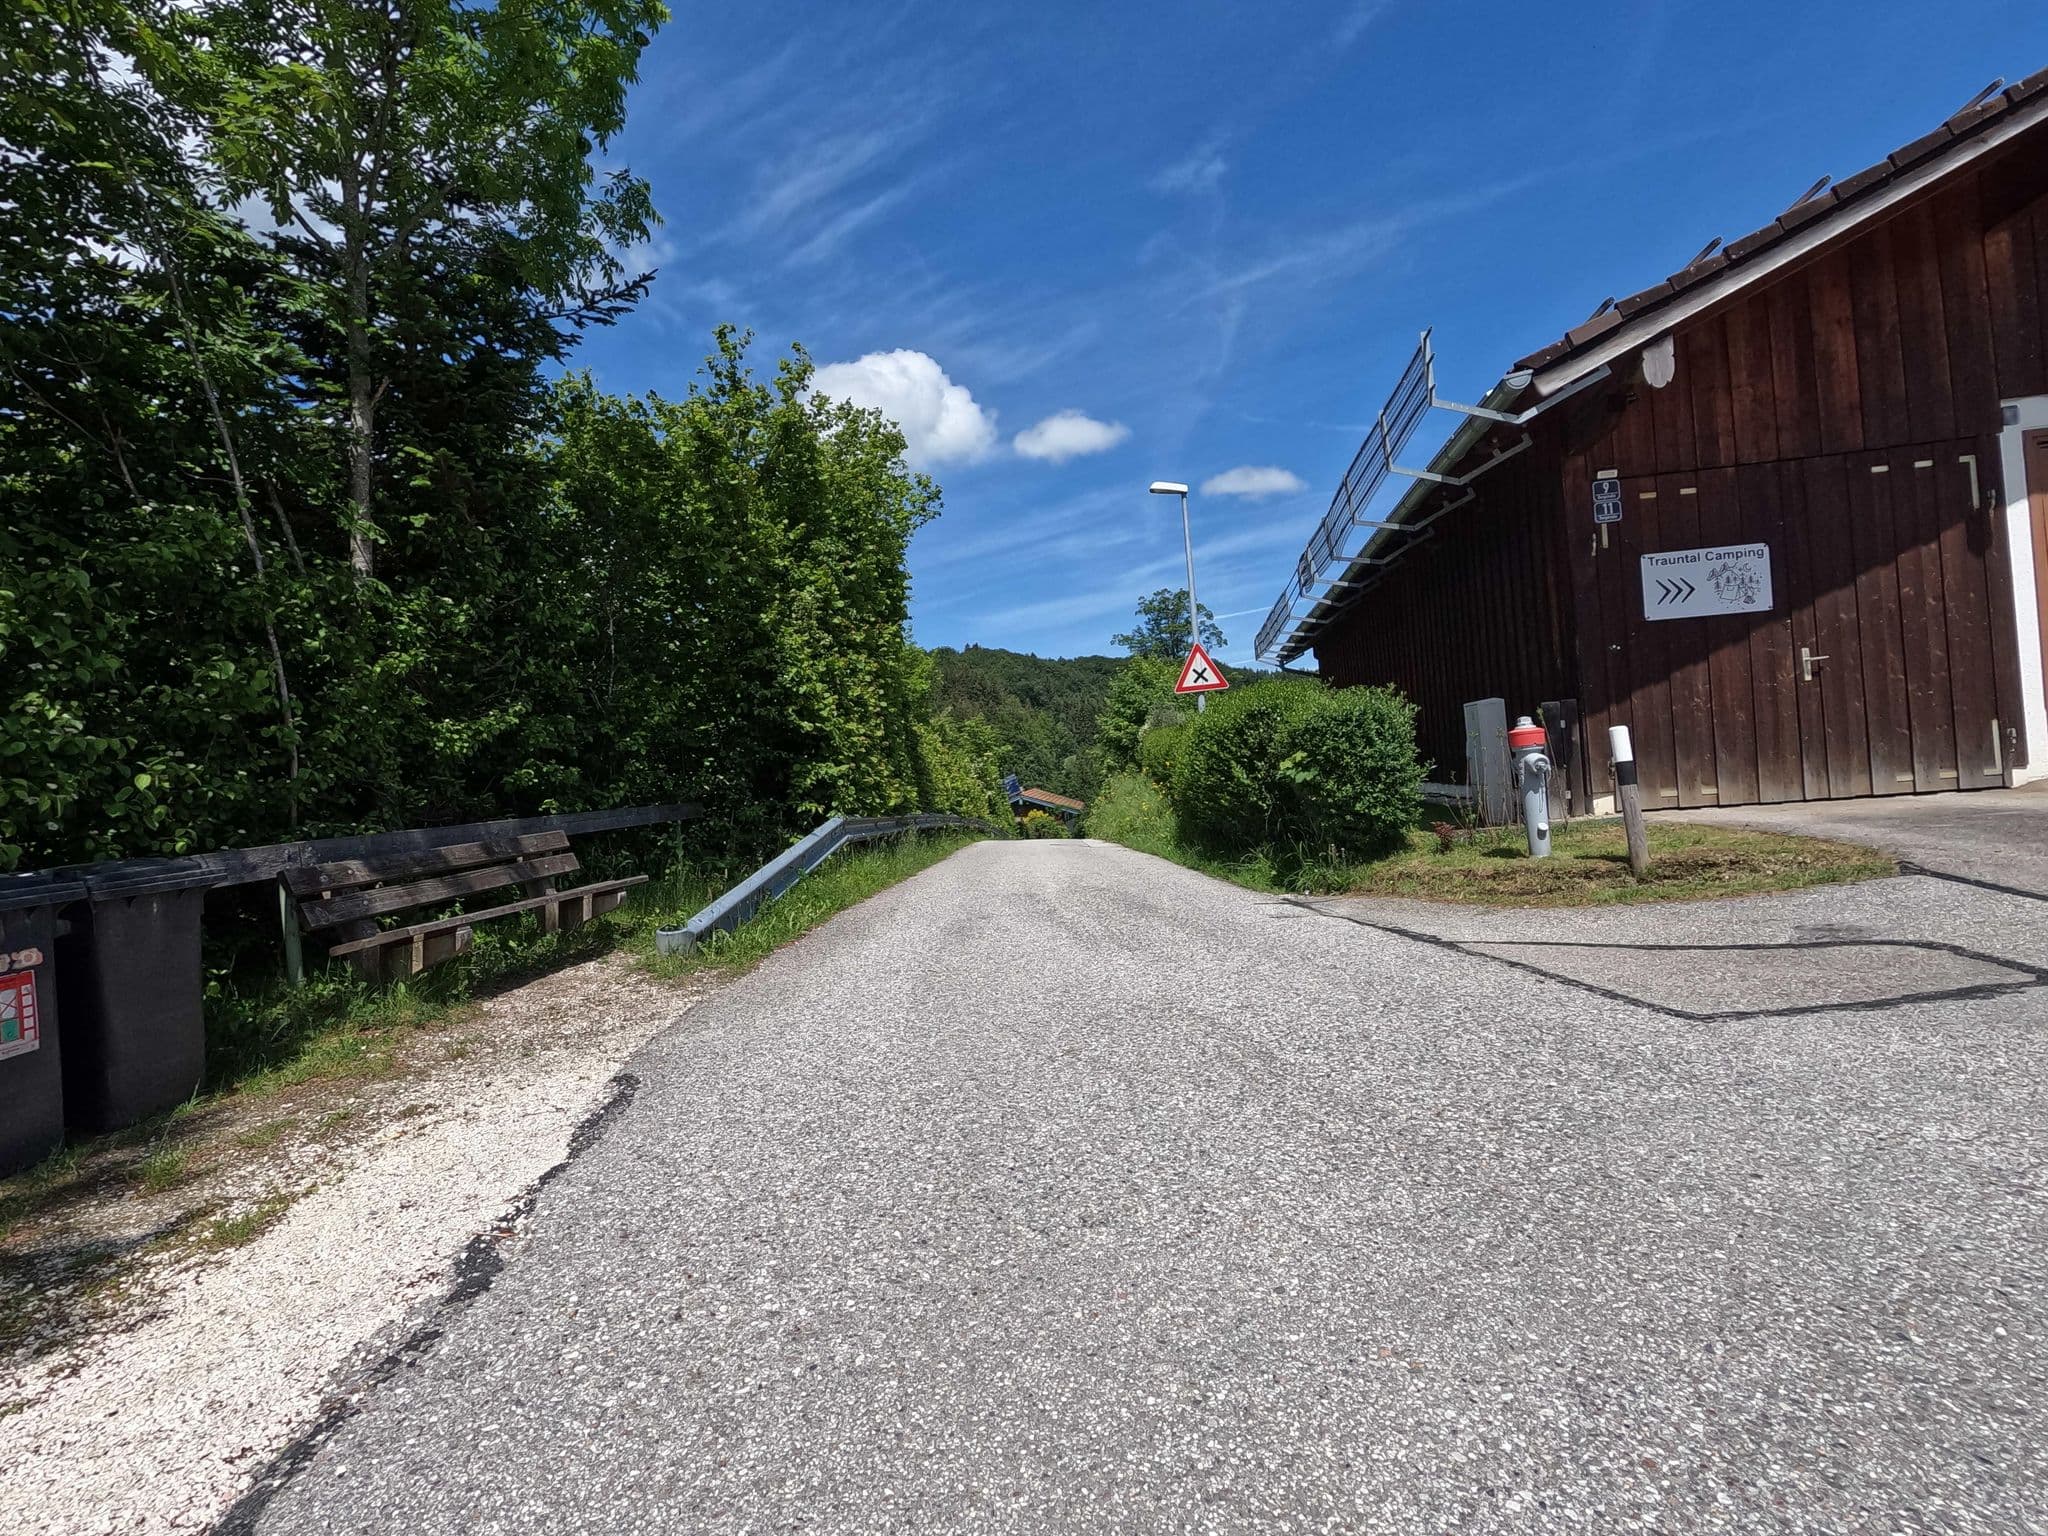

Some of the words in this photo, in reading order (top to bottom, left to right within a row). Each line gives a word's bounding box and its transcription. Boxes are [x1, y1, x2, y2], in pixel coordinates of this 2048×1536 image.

[1602, 482, 1610, 494] 9
[1602, 502, 1614, 515] 11
[1648, 553, 1701, 567] Trauntal
[1705, 548, 1765, 562] Camping
